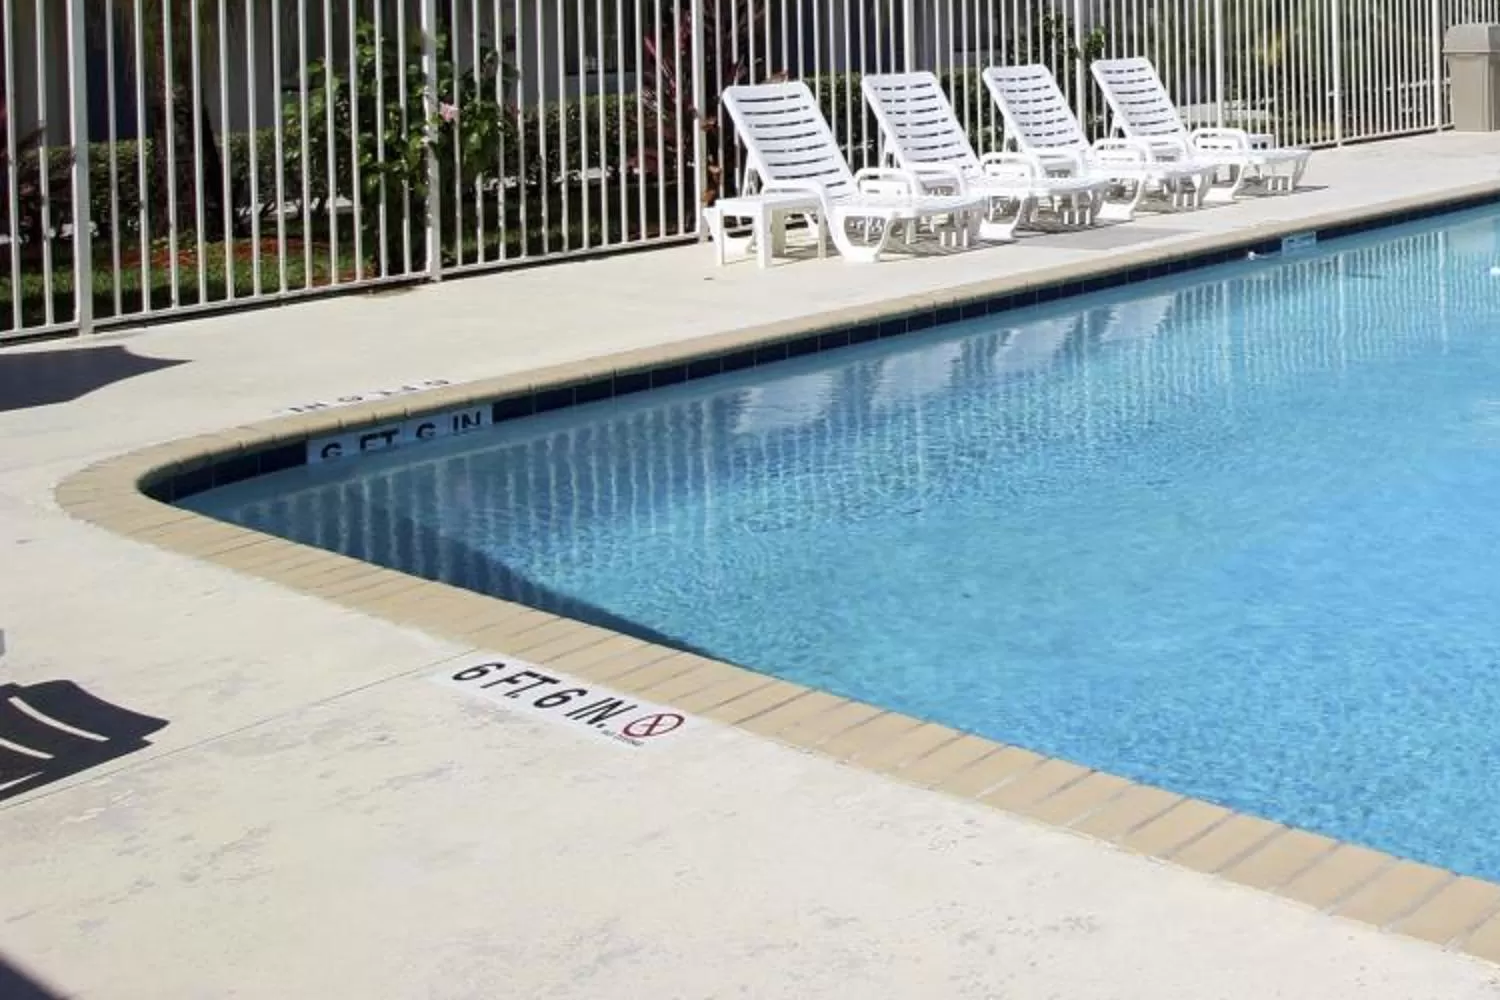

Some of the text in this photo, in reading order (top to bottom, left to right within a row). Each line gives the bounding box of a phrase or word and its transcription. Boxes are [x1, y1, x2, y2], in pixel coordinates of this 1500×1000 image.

[452, 410, 481, 434] IN
[451, 661, 639, 729] 6 FT. 6 IN.
